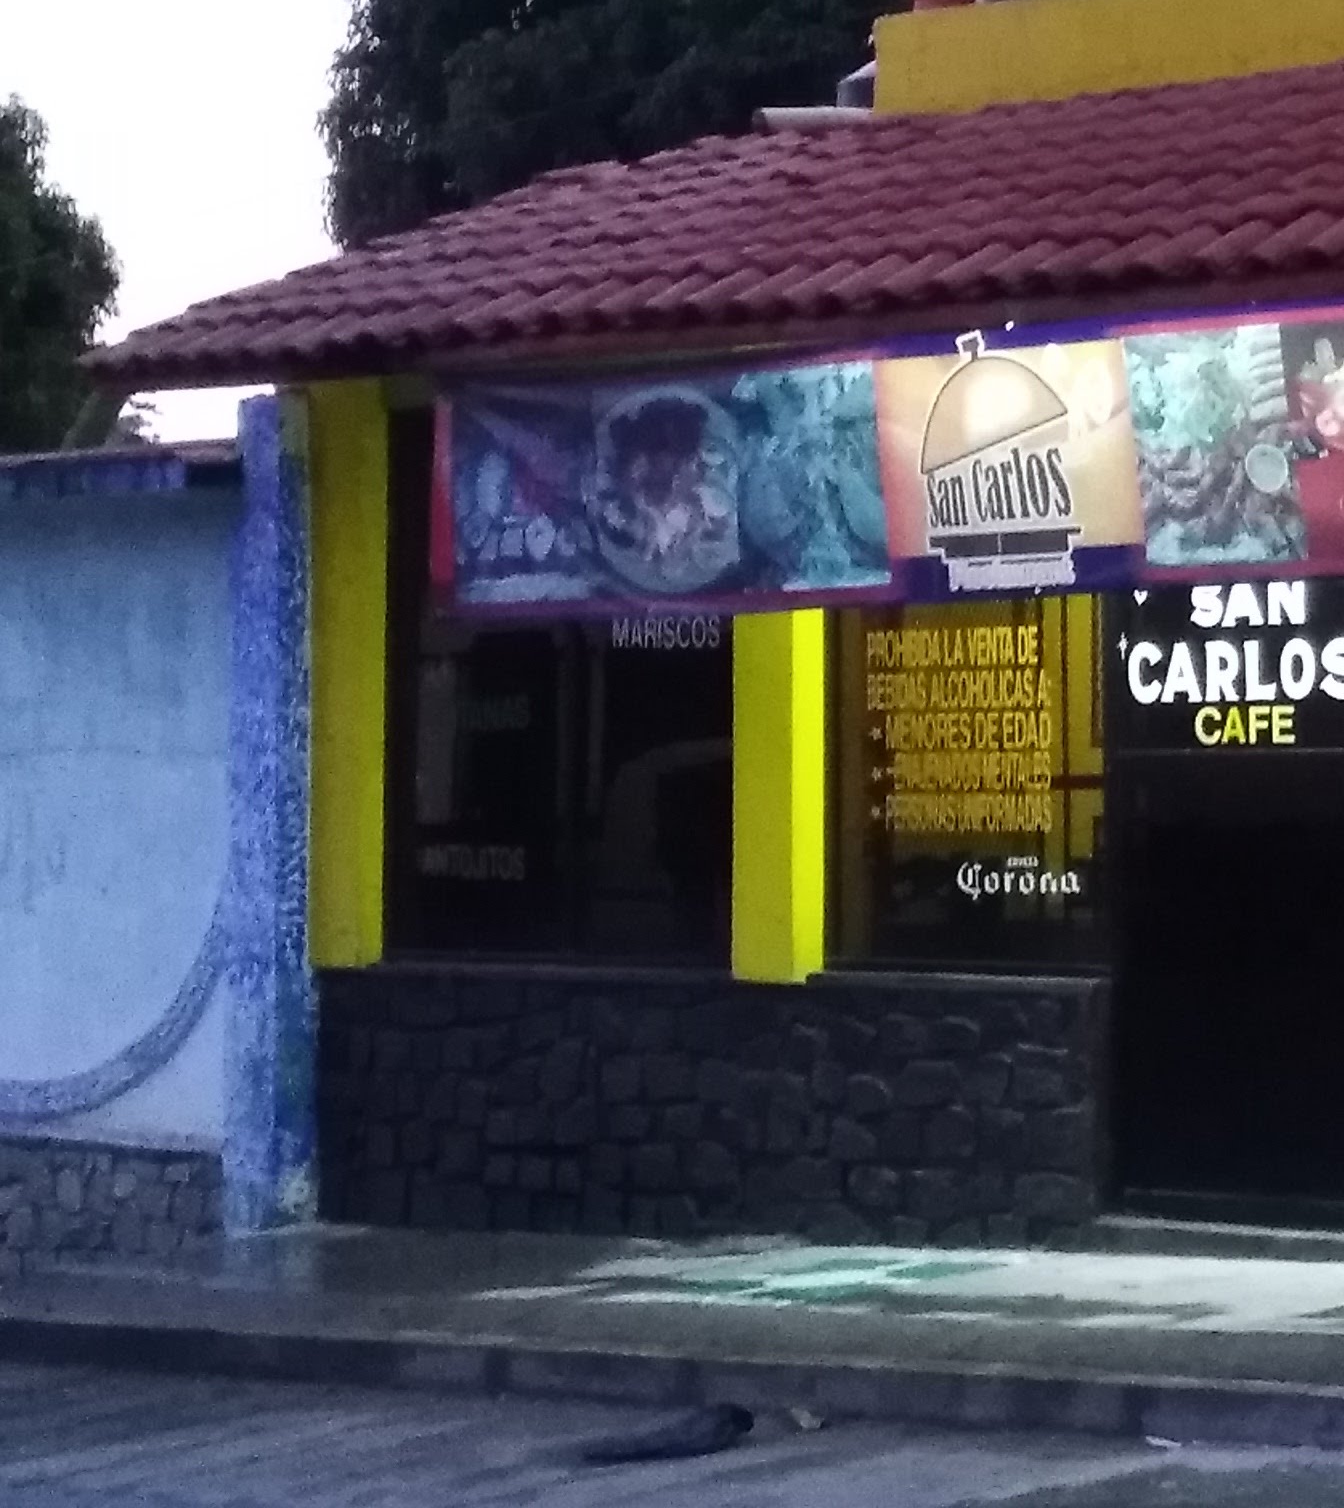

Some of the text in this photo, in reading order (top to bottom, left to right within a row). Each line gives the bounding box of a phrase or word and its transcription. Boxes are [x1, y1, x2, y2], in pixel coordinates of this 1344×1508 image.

[926, 447, 1071, 528] San Carlos
[1190, 581, 1306, 628] SAN
[612, 614, 720, 649] MARISCOS
[967, 626, 1015, 666] VENTA
[1018, 625, 1039, 665] DE
[975, 711, 1000, 749] DE
[1002, 711, 1052, 749] EDAD
[1194, 705, 1296, 746] CAFE
[956, 860, 1081, 900] Corona
